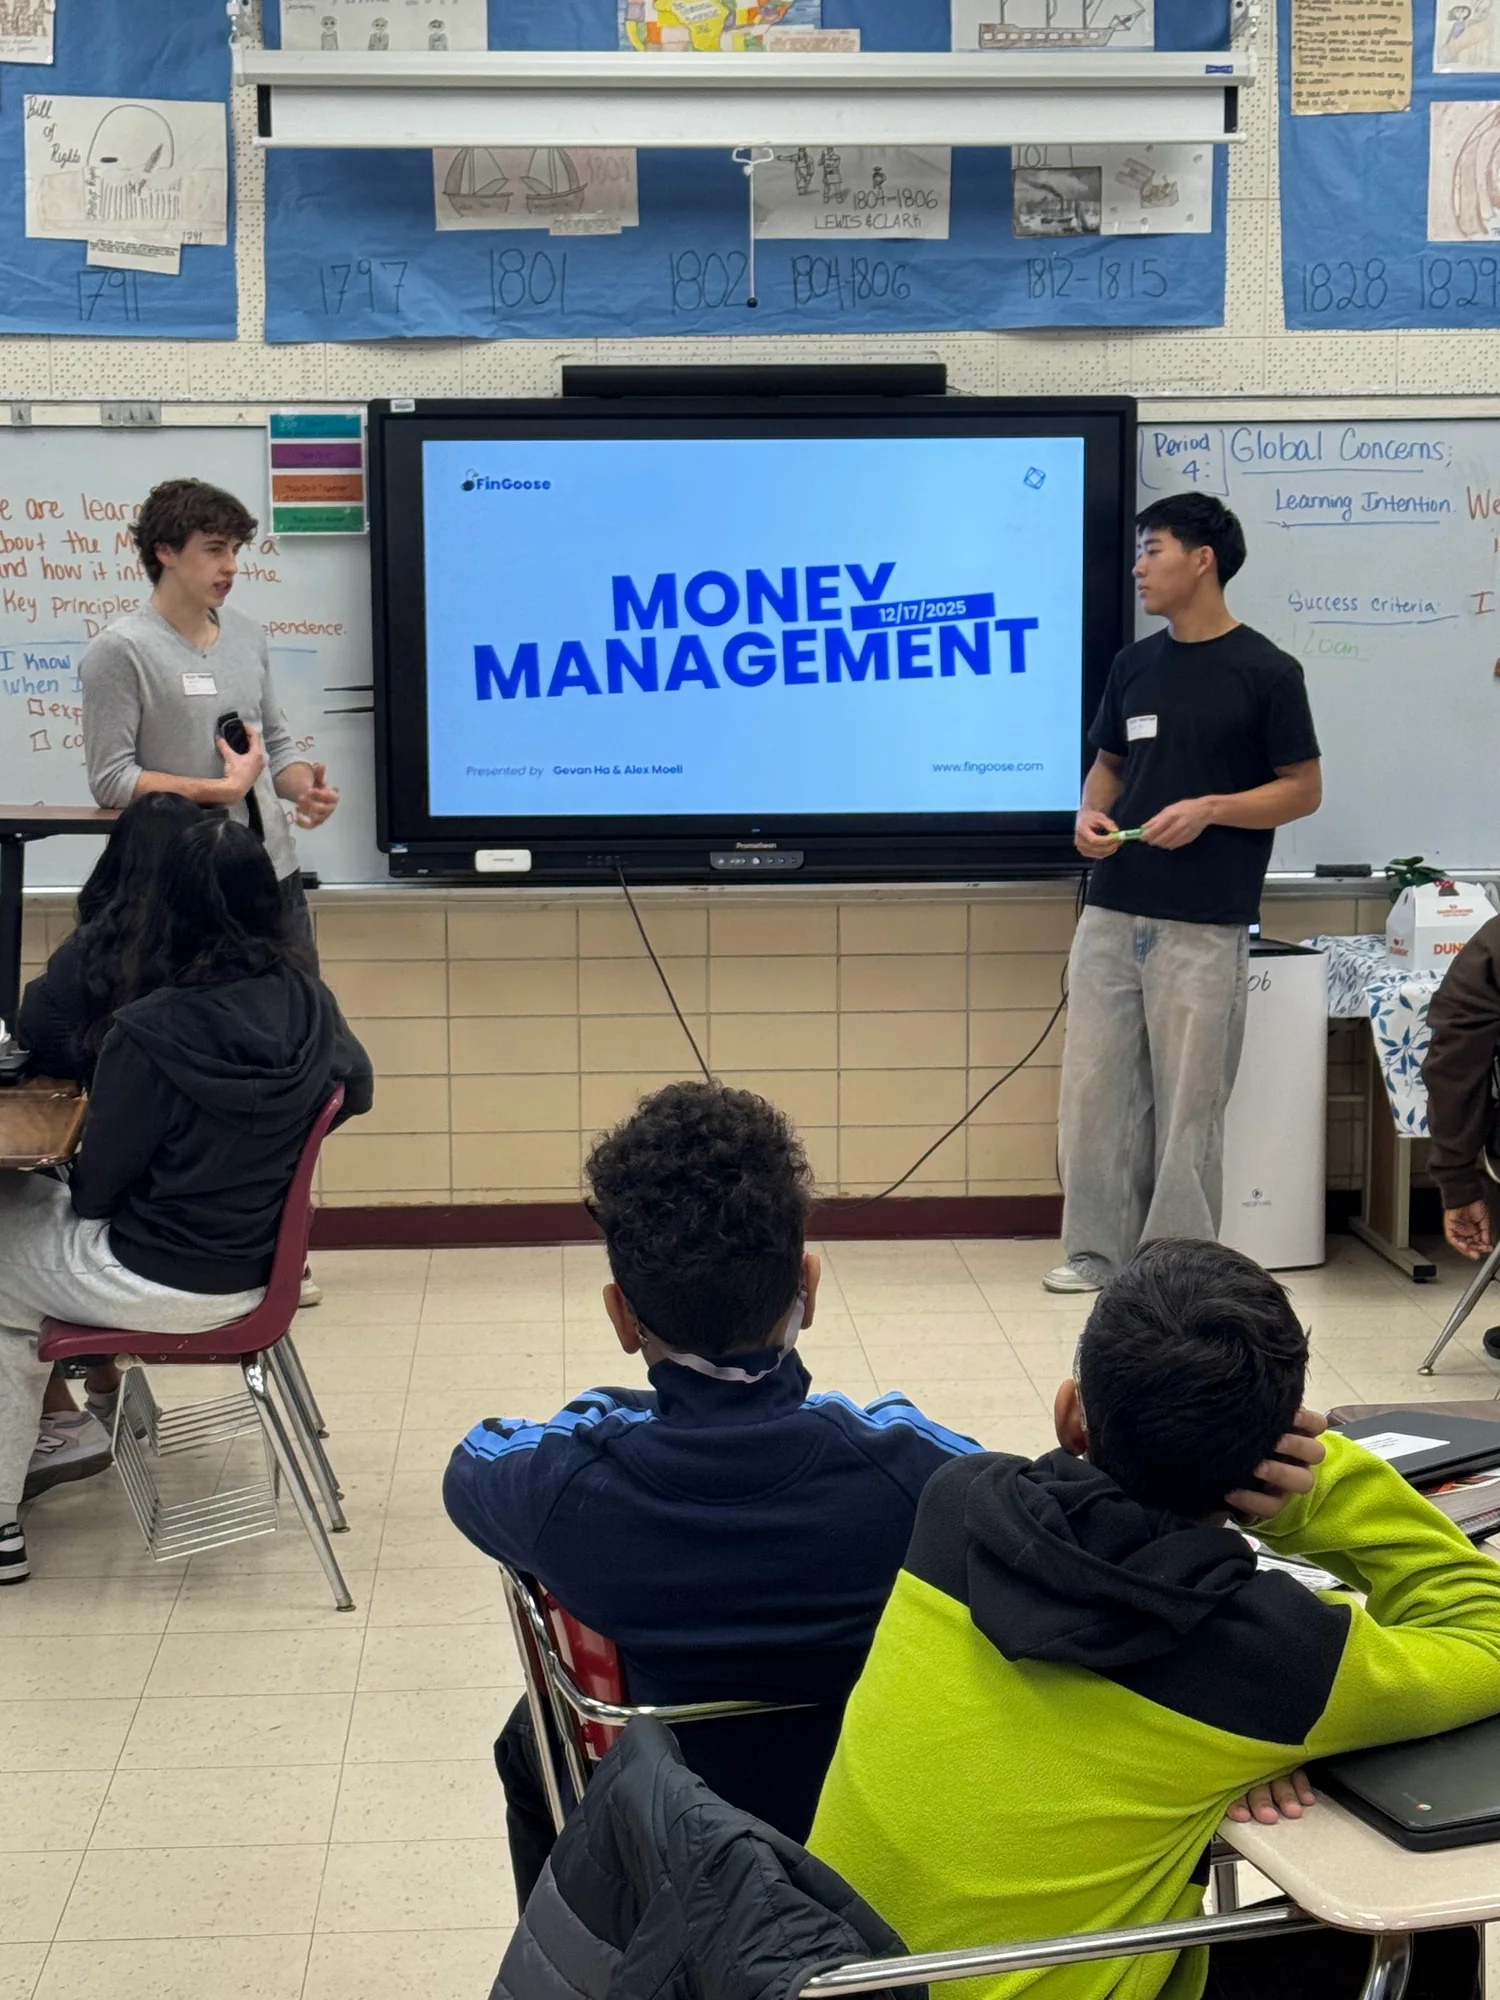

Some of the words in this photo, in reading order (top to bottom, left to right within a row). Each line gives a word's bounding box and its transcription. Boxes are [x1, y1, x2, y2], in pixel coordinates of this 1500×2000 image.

[26, 96, 53, 120] Bill
[51, 143, 82, 168] Rights
[853, 188, 939, 211] 1804-1806
[814, 214, 862, 230] LEWIS
[320, 259, 408, 314] 1797
[489, 248, 567, 316] 1801
[669, 249, 750, 316] 1802
[791, 255, 912, 312] 1804-1806
[1302, 257, 1388, 313] 1828
[1419, 256, 1498, 311] 1829
[77, 270, 140, 321] 1791
[1153, 432, 1211, 458] Period
[1231, 426, 1323, 463] Global
[476, 475, 552, 491] FinGoose
[25, 498, 65, 521] are
[1275, 488, 1352, 522] Learning
[62, 529, 101, 554] the
[40, 556, 82, 580] how
[89, 562, 107, 580] it
[240, 561, 282, 583] the
[3, 587, 37, 624] Key
[879, 600, 967, 624] 12/17/2025
[1288, 591, 1358, 612] Success
[1470, 590, 1496, 615] I
[474, 617, 1039, 701] MANAGEMENT
[466, 765, 527, 777] Presented
[529, 765, 545, 779] by
[553, 765, 592, 775] Gevan
[594, 764, 610, 775] Ha
[613, 764, 621, 775] &
[624, 764, 650, 775] Alex
[932, 761, 1045, 775] www.fingoose.com
[1433, 942, 1466, 955] DUN
